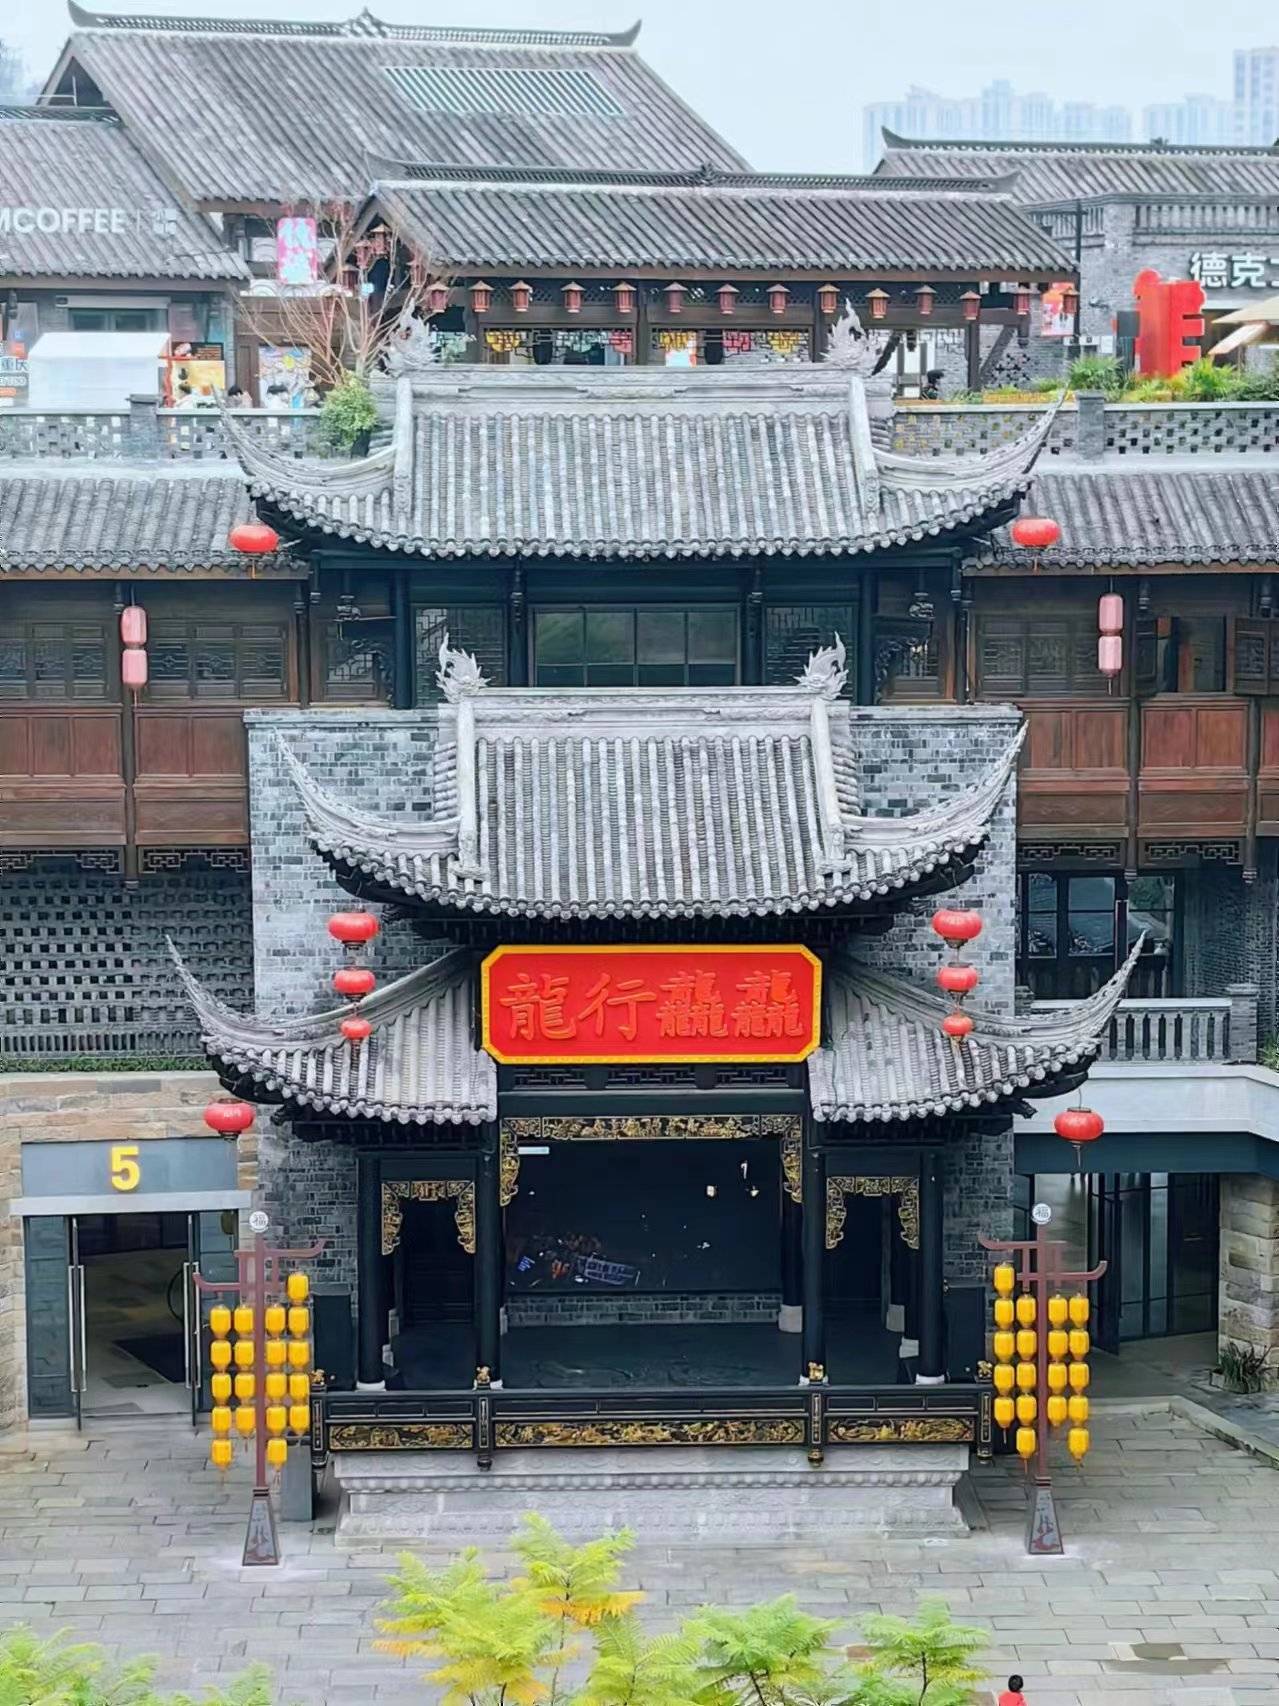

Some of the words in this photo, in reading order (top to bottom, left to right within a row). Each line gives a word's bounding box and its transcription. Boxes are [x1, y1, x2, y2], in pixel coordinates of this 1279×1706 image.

[1190, 252, 1279, 288] 德克
[499, 969, 805, 1042] 龍行龘龘
[109, 1145, 141, 1191] 5
